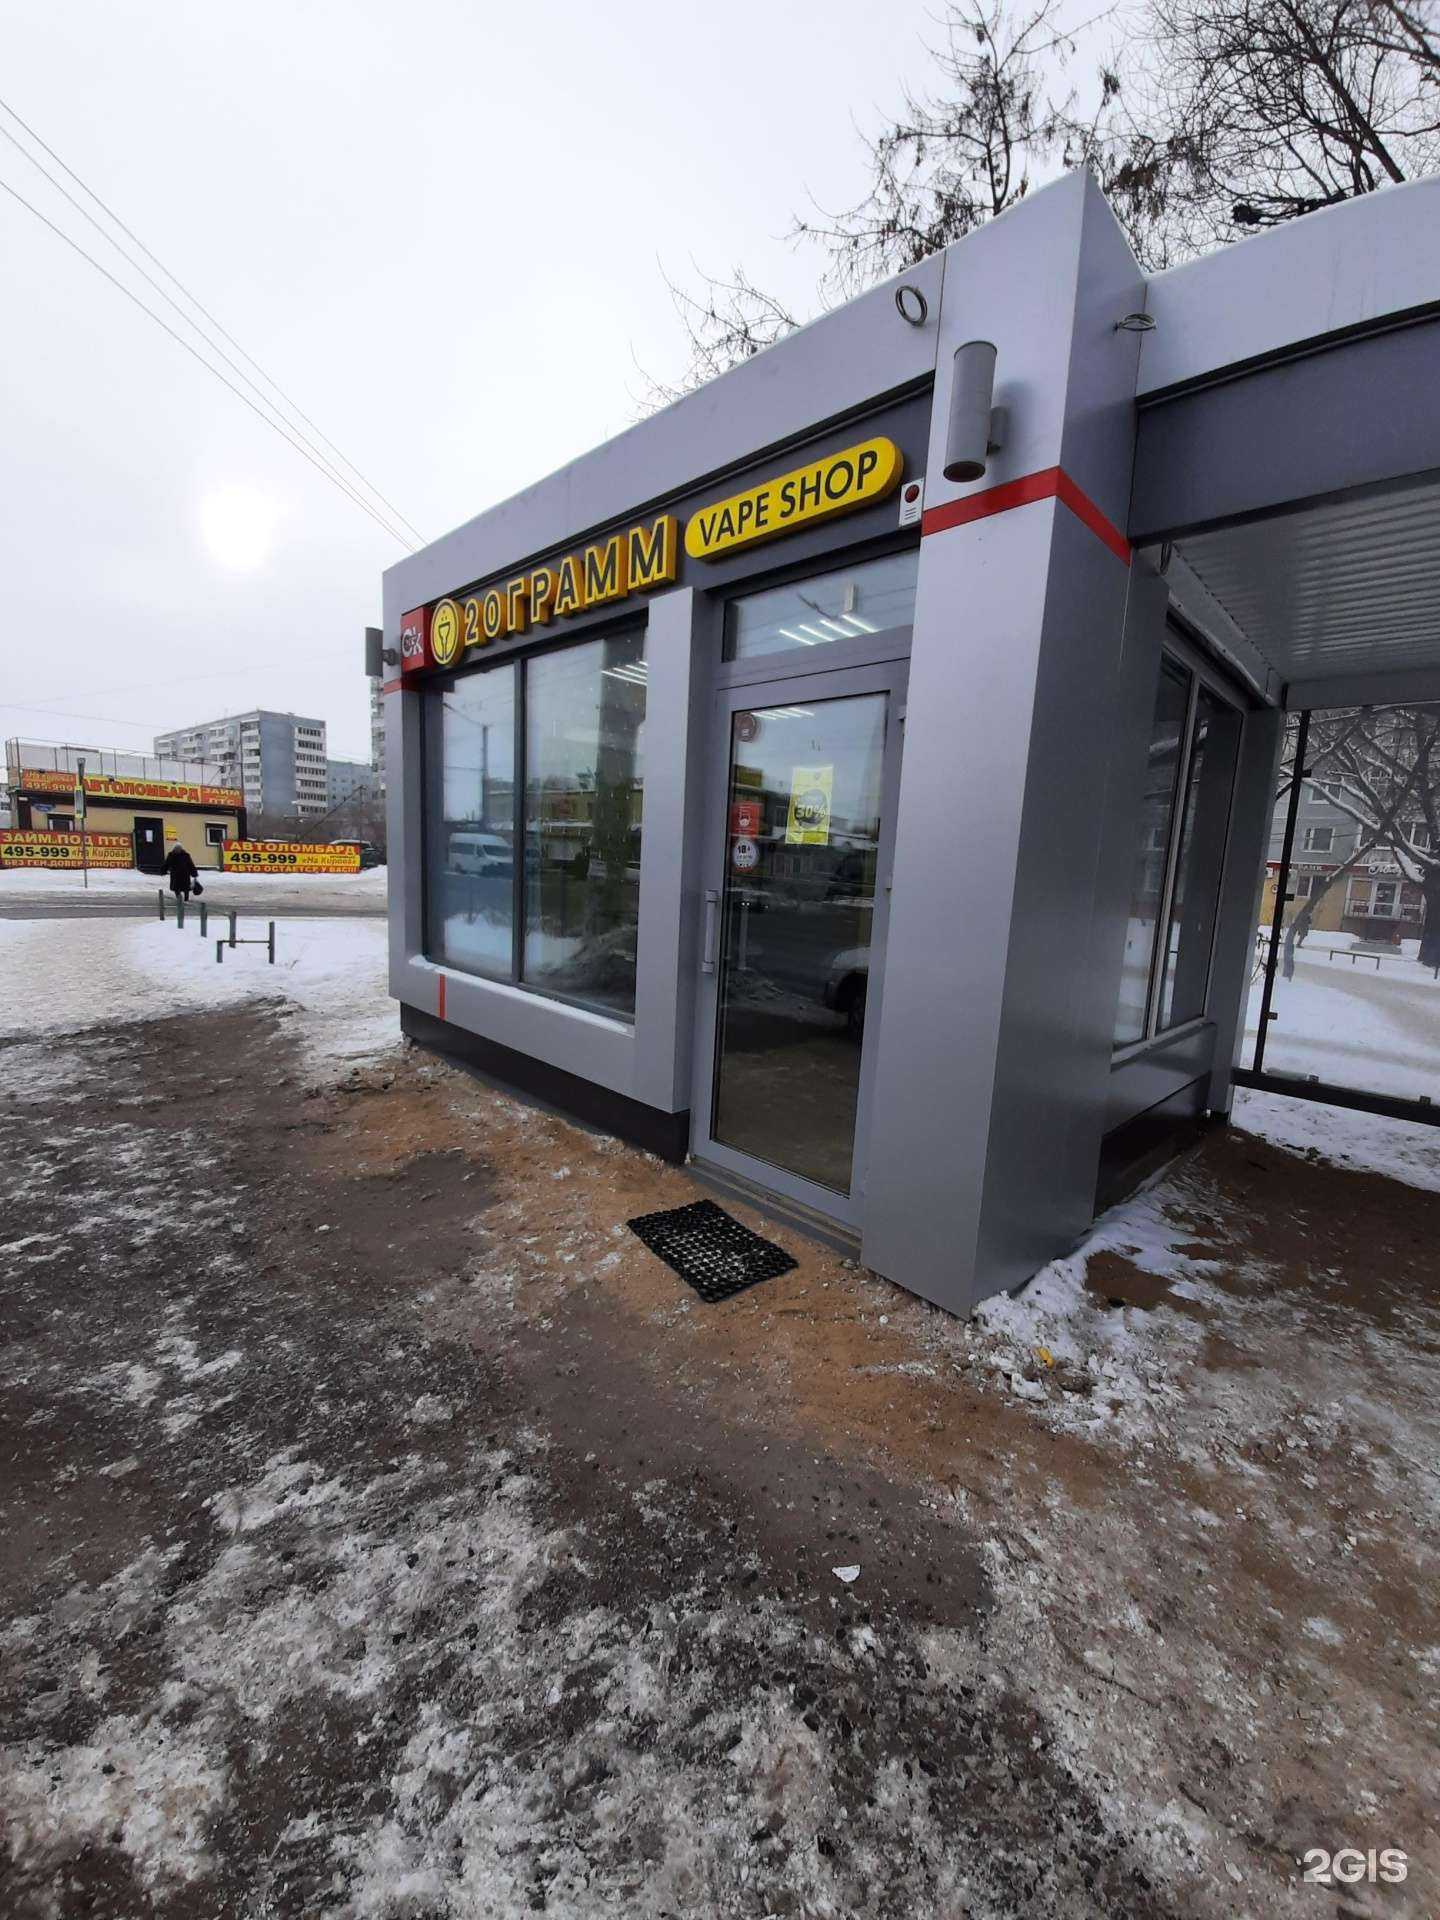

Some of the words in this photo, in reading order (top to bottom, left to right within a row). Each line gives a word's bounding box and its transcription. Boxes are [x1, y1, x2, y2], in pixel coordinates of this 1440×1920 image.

[699, 492, 770, 547] VAPE
[779, 450, 878, 518] SHOP
[82, 778, 199, 802] АВТОЛОМБАРД
[98, 836, 130, 847] ПТС
[3, 846, 70, 858] 495-999
[229, 841, 356, 856] АВТОЛОМБАРД
[230, 852, 298, 865] 495-999
[230, 864, 261, 873] АВТО
